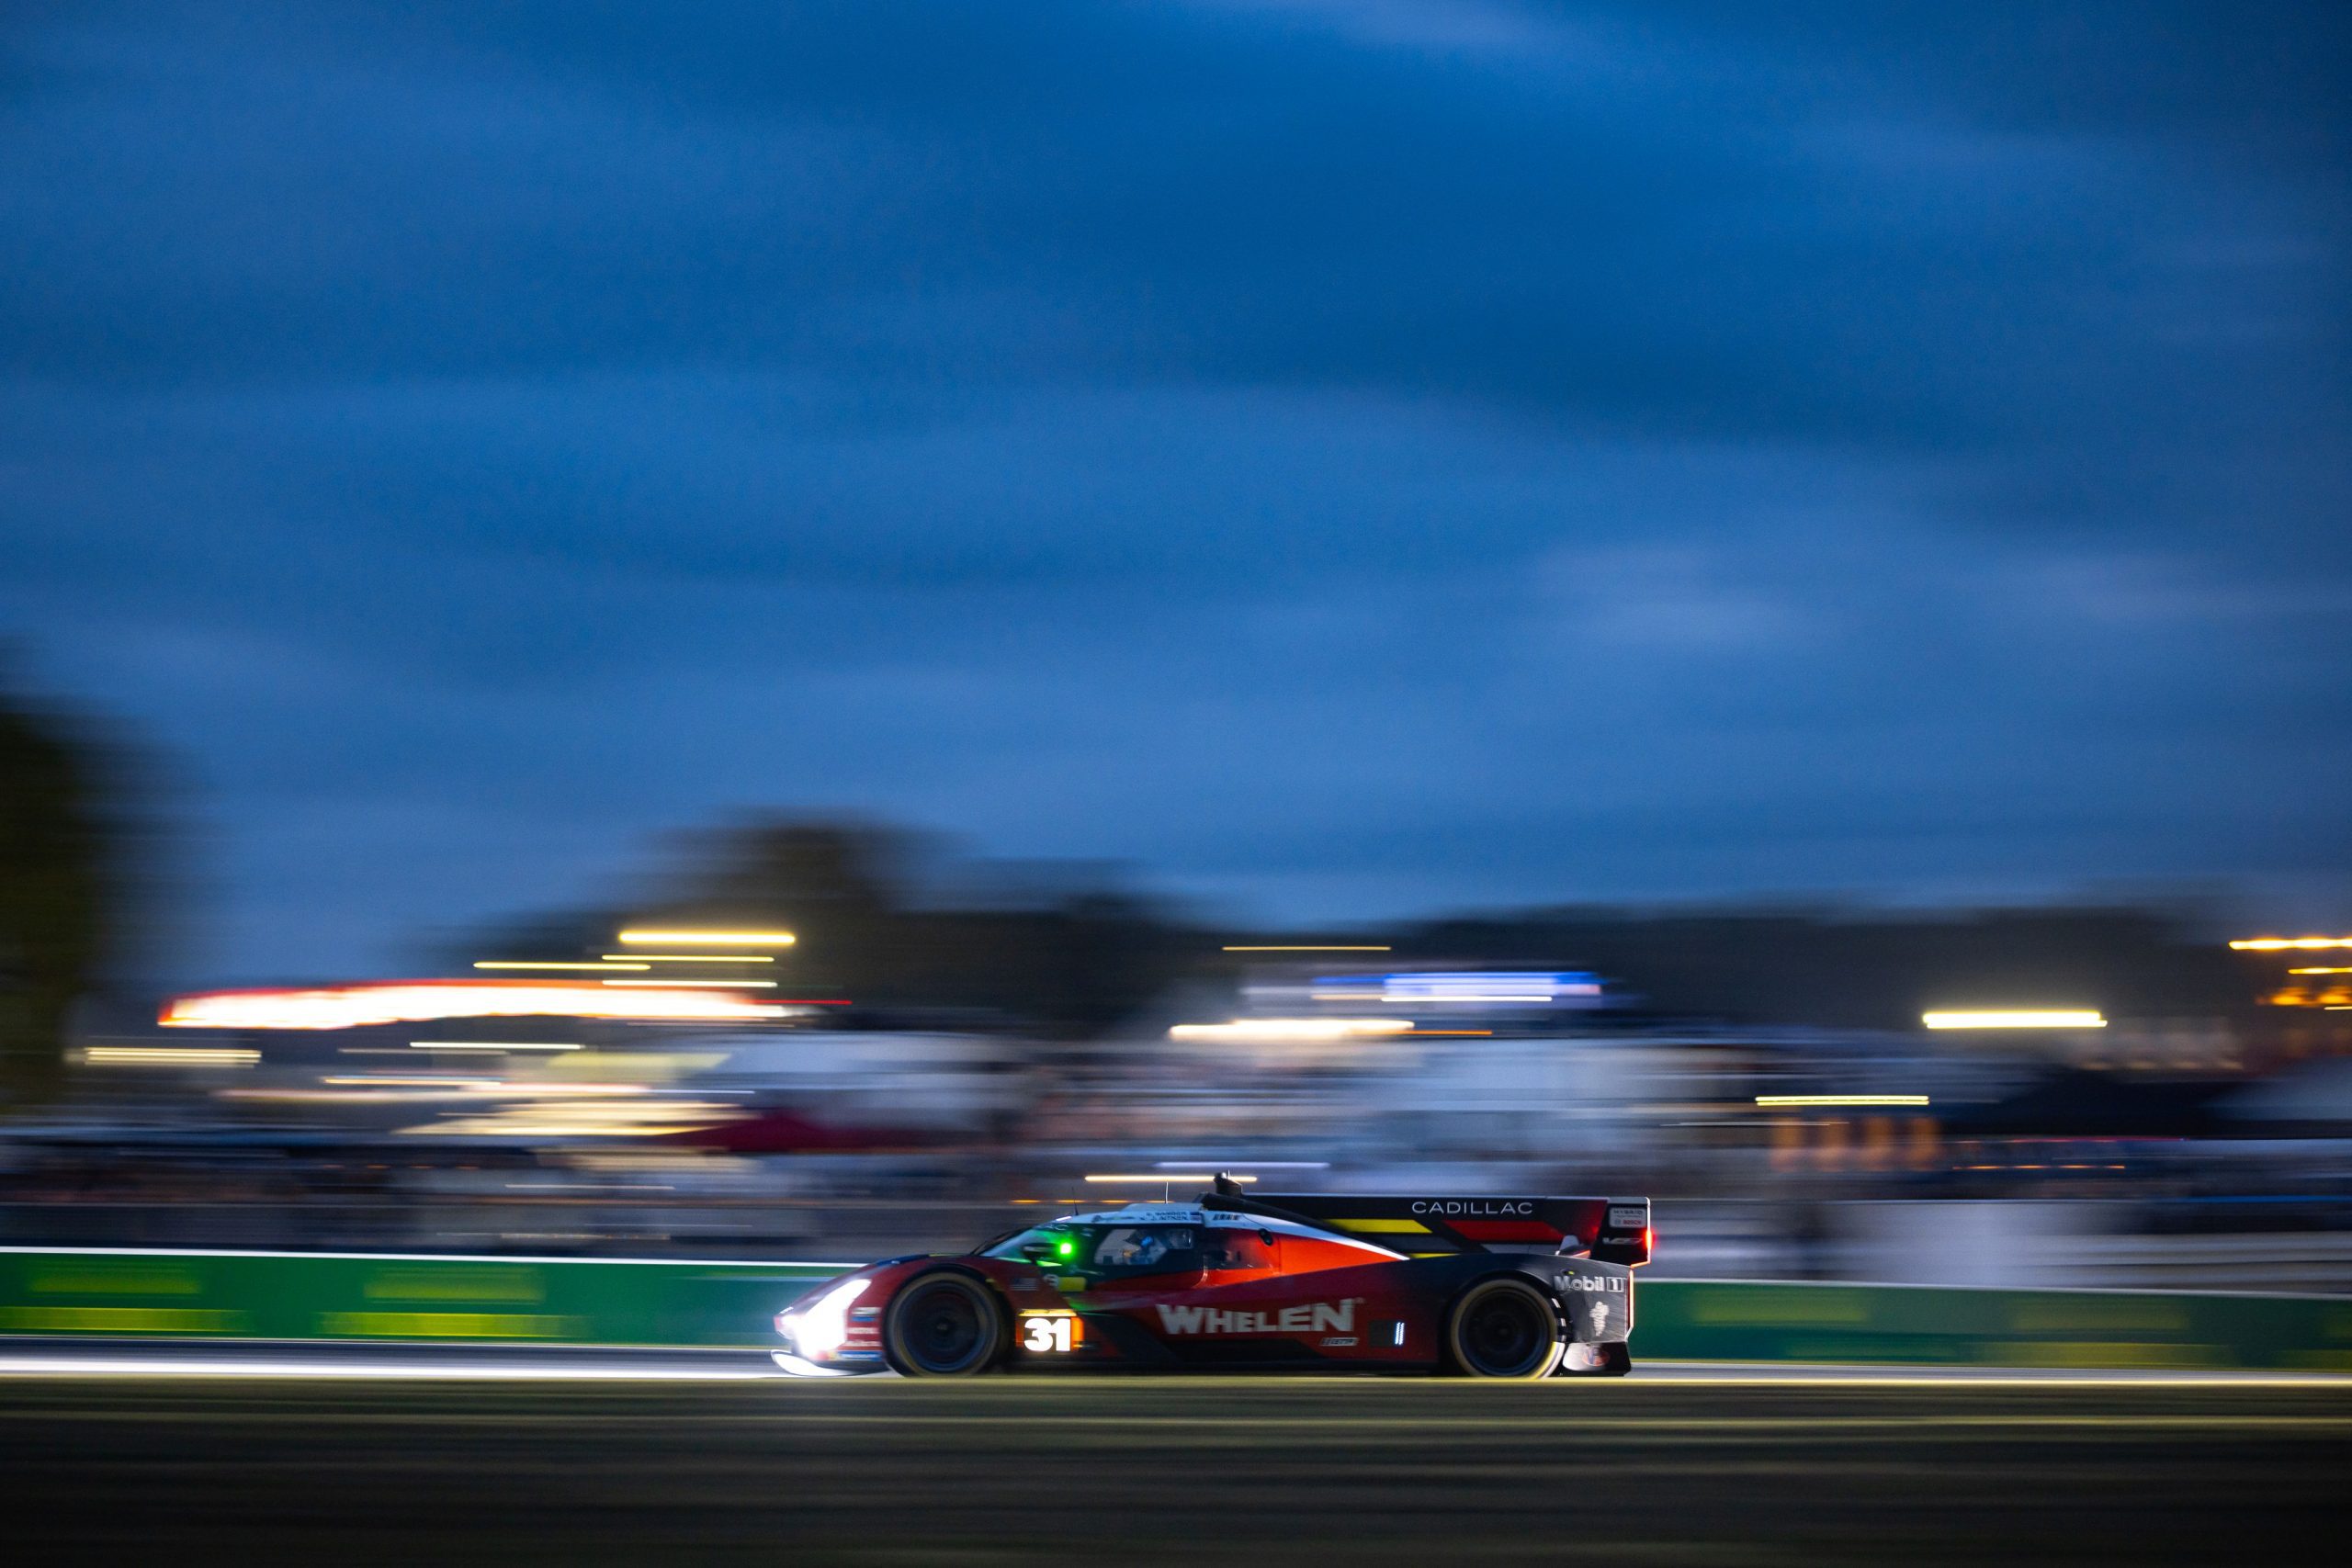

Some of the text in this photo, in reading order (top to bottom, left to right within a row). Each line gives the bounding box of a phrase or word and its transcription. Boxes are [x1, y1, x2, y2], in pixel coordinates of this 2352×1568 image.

[1412, 1201, 1532, 1214] CADILLAC
[1554, 1276, 1605, 1292] Mobil
[1155, 1298, 1353, 1334] WHELEN
[1024, 1317, 1070, 1351] 31
